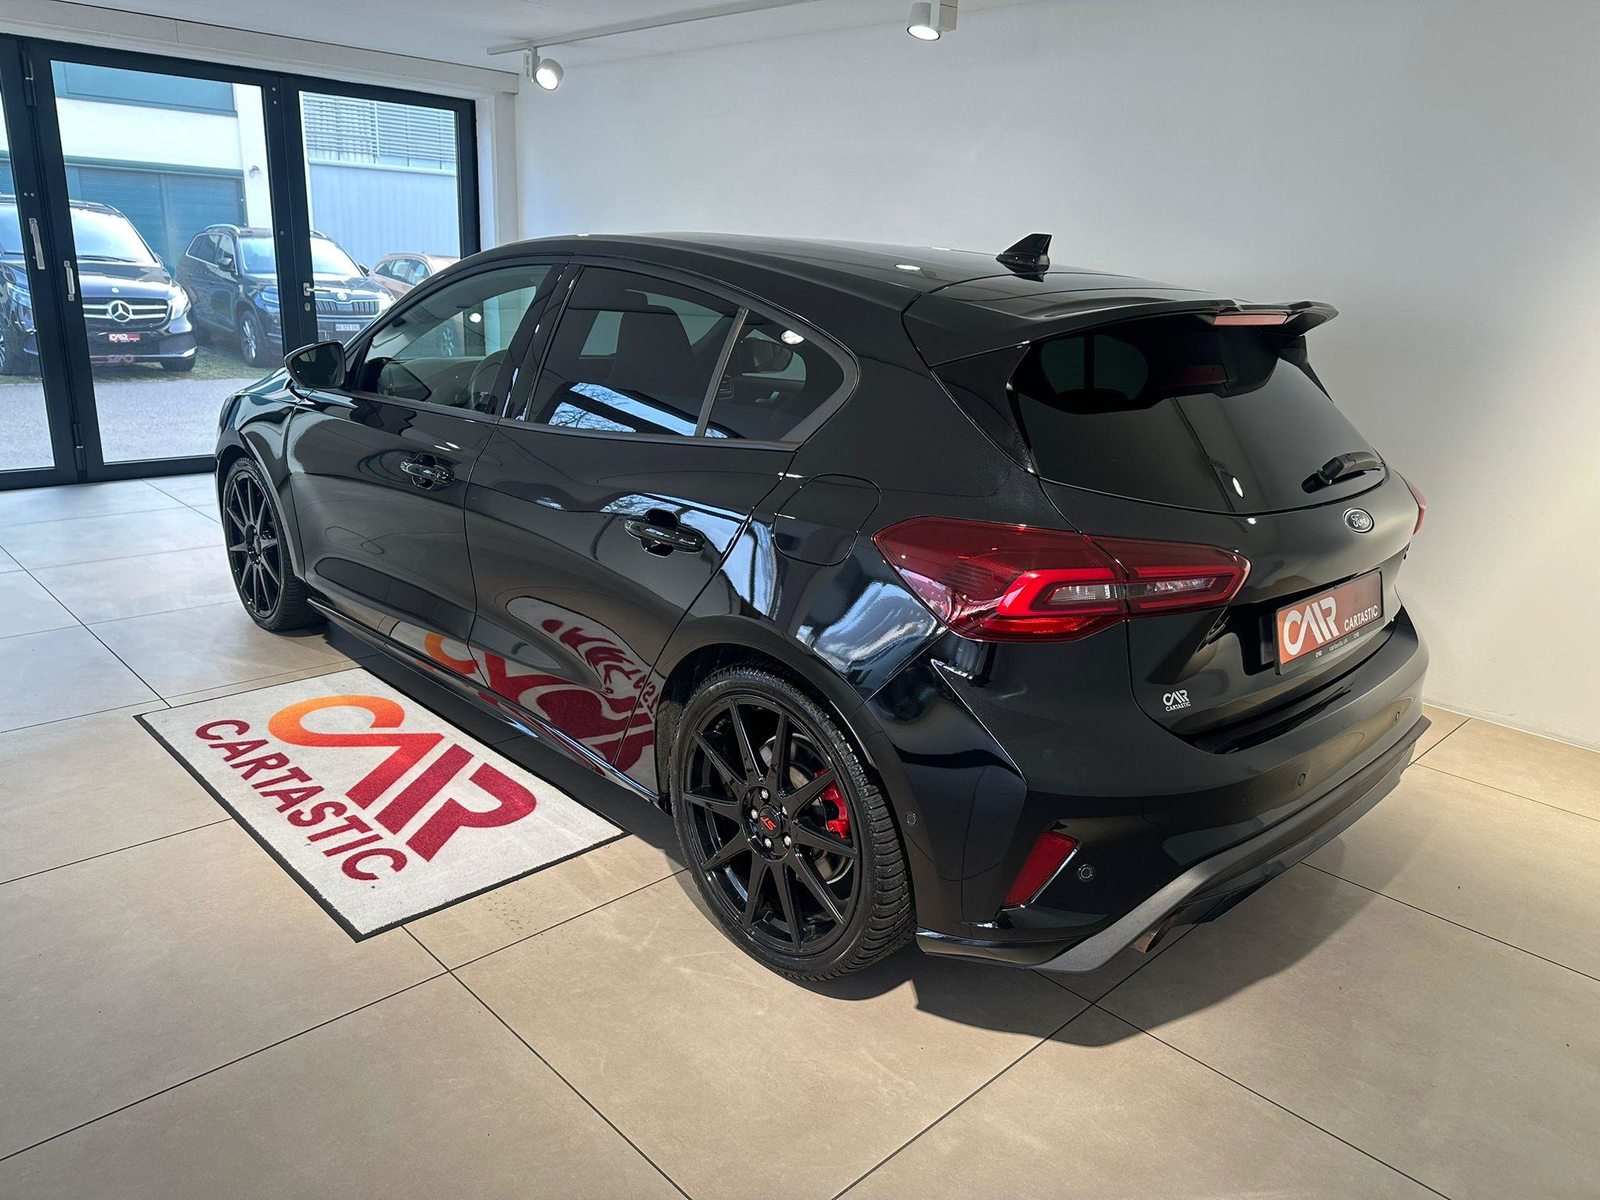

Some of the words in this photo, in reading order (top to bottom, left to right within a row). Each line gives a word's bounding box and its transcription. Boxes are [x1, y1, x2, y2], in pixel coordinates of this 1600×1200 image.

[1344, 605, 1378, 632] CARTASTIC
[1165, 701, 1191, 712] CARTASTIC
[194, 718, 408, 881] CARTASTIC
